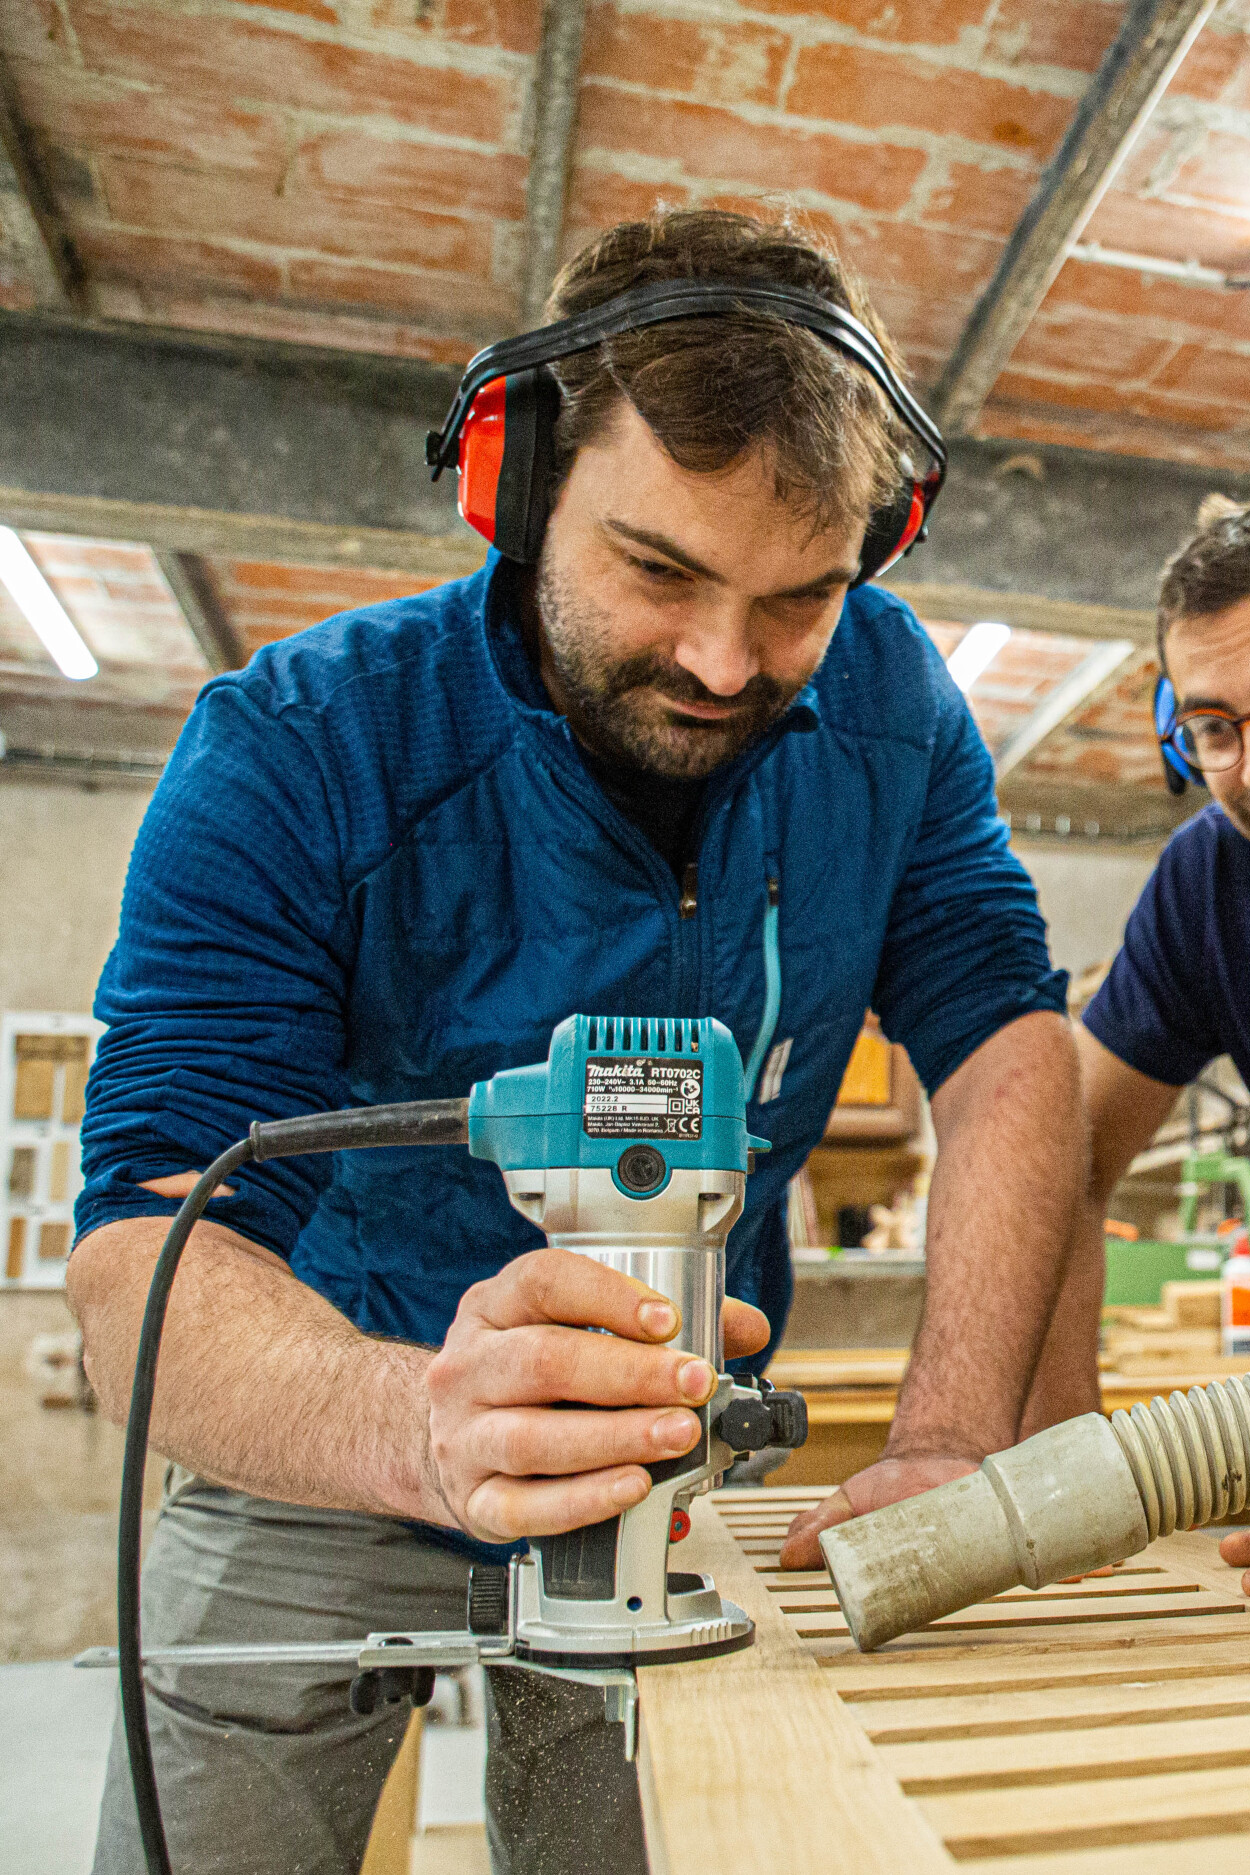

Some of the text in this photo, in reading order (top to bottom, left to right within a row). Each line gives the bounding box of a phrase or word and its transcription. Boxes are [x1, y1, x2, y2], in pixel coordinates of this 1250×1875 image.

[586, 1064, 645, 1077] Makita
[651, 1068, 701, 1079] RT0702C
[678, 1117, 700, 1133] CE
